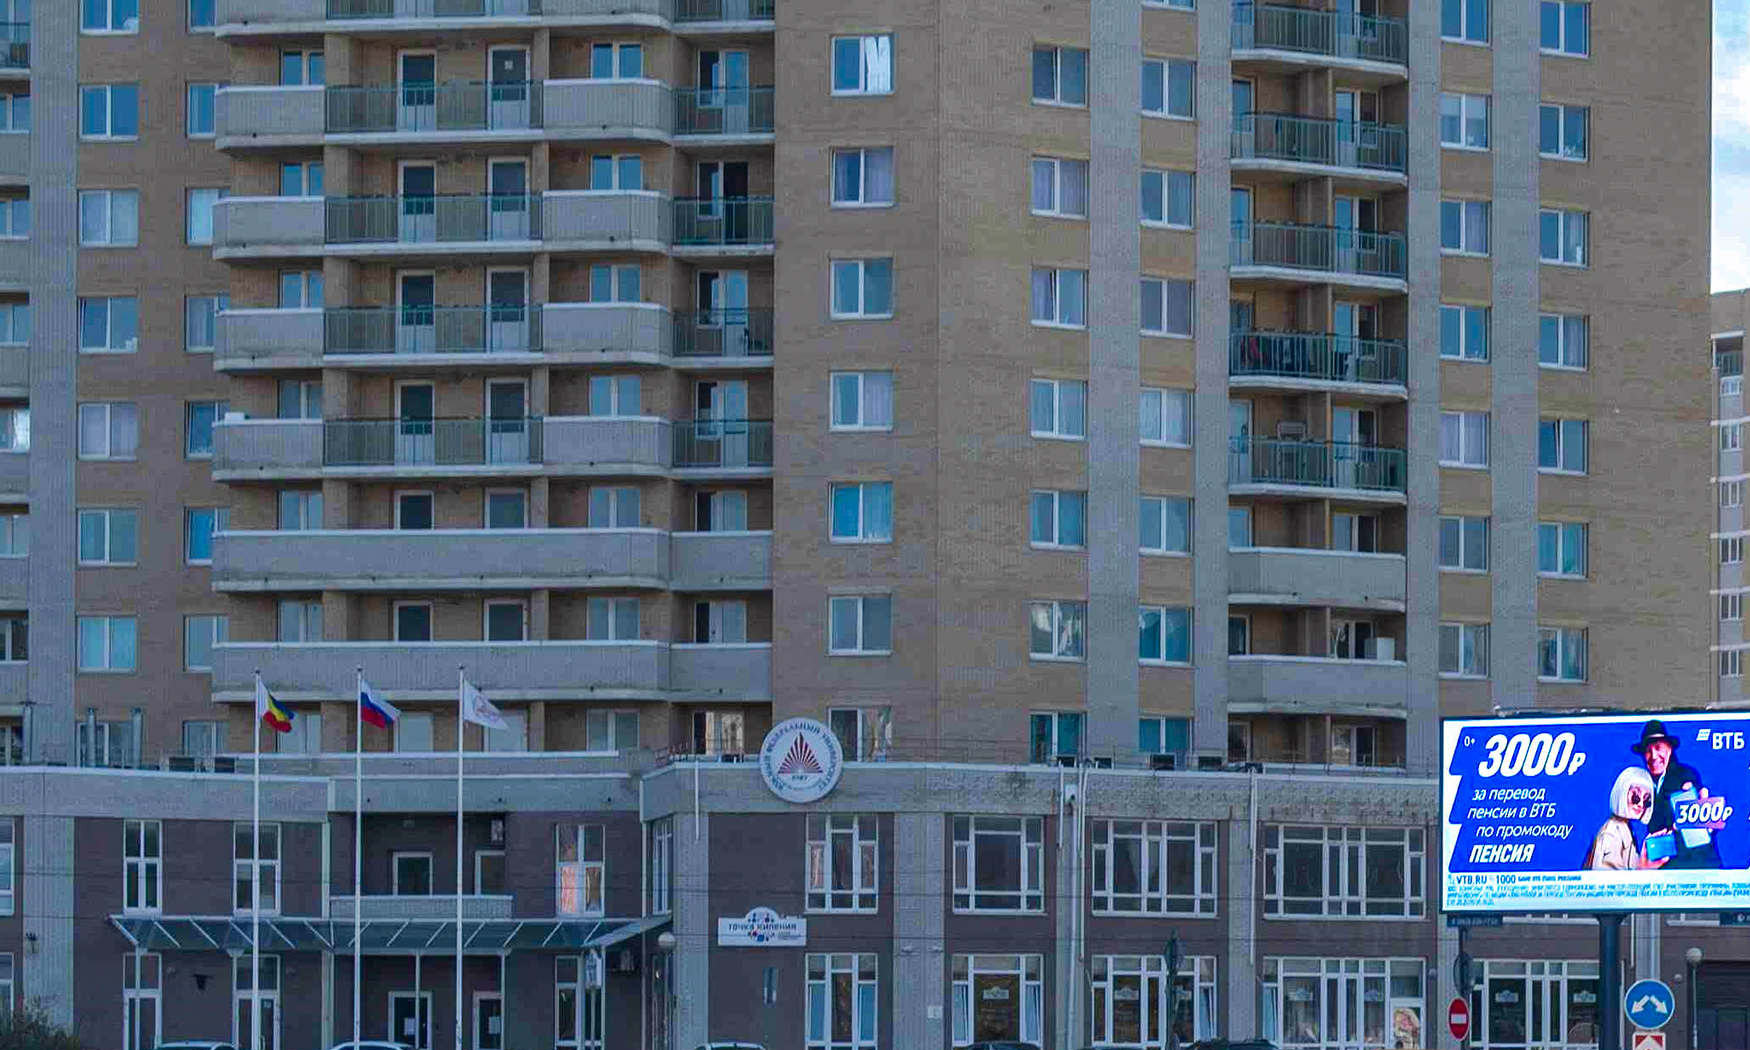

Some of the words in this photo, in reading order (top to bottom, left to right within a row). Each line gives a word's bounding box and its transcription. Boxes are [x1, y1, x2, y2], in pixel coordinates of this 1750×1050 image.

[1464, 735, 1476, 747] 0+
[1712, 732, 1745, 750] ВТБ
[1472, 789, 1487, 801] за
[1488, 788, 1546, 803] перевод
[1467, 807, 1516, 819] пенсии
[1518, 807, 1527, 818] в
[1529, 803, 1557, 818] ВТБ
[1476, 826, 1494, 837] по
[1495, 825, 1574, 841] промокоду
[1469, 844, 1536, 863] ПЕНСИЯ
[1456, 875, 1488, 885] VTB.RU
[1496, 874, 1517, 885] 1000
